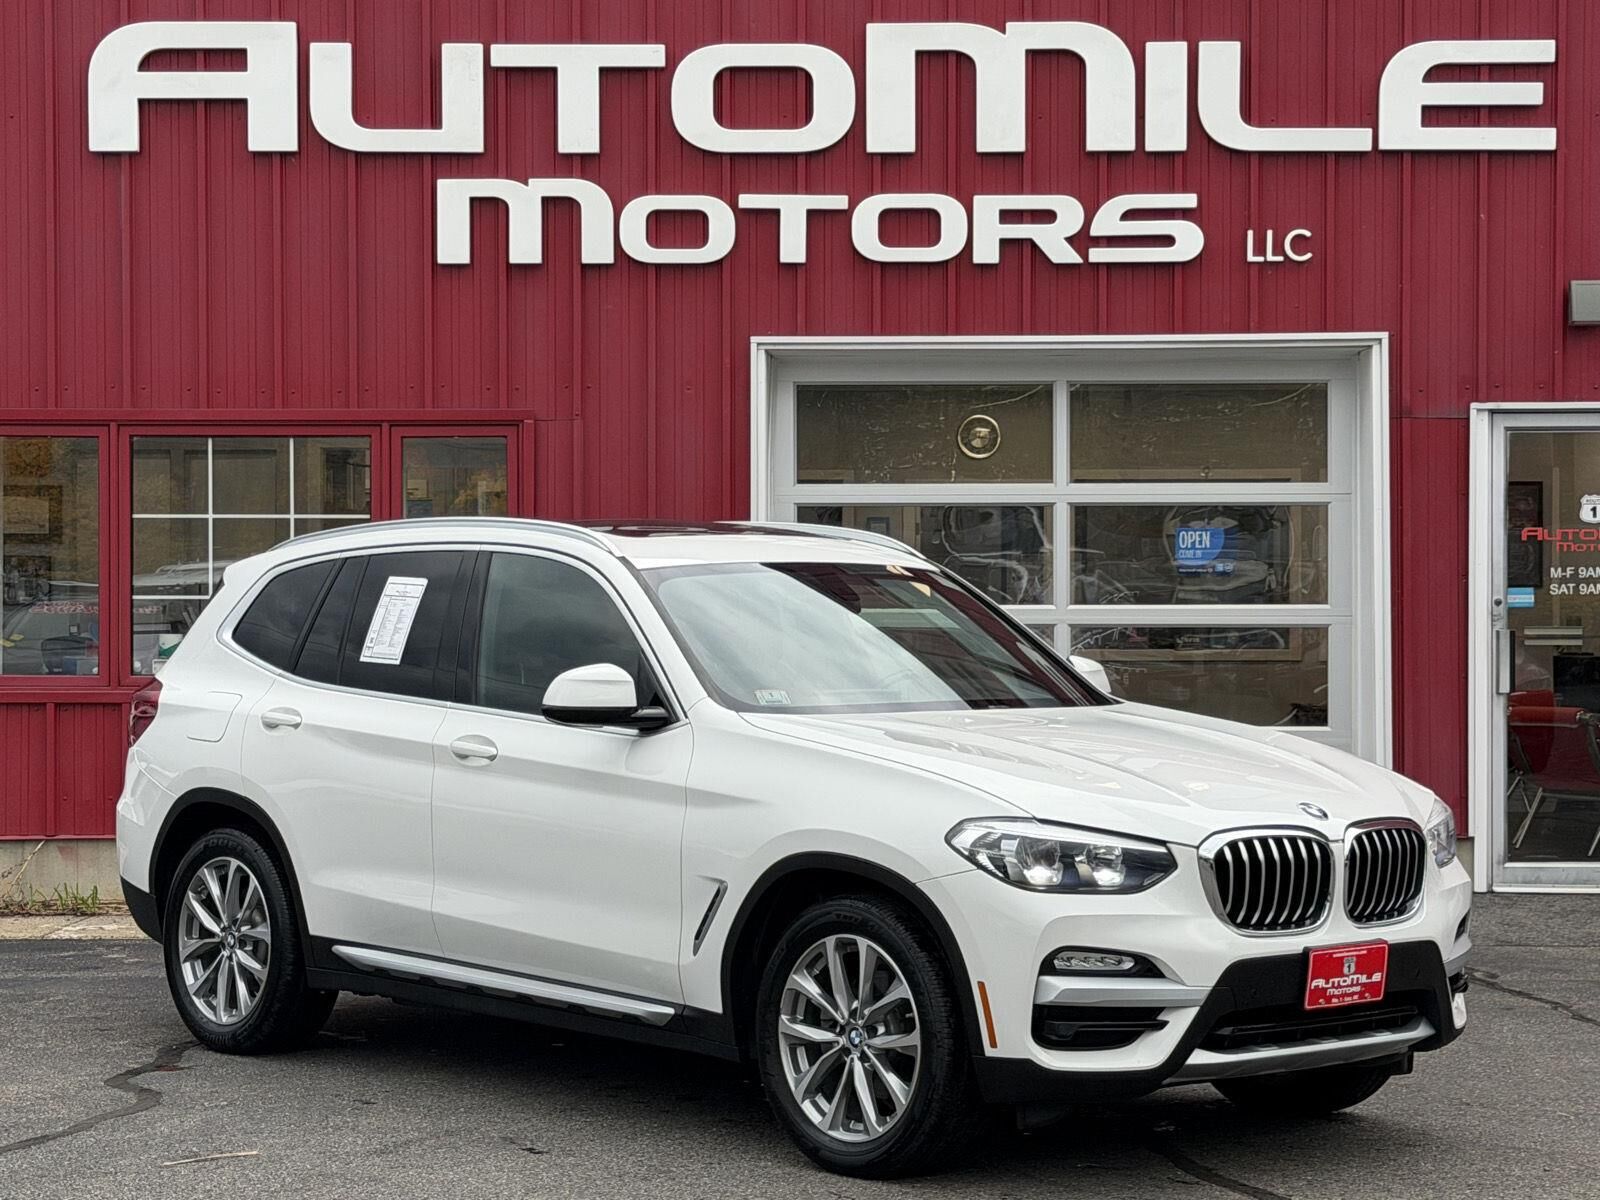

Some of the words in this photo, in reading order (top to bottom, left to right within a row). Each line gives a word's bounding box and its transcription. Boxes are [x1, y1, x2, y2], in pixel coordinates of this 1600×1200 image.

[88, 21, 1557, 153] AUTOMILE
[436, 177, 1205, 264] MOTORS
[1246, 228, 1313, 262] LLC
[1179, 531, 1210, 548] OPEN
[1521, 527, 1600, 541] AUTO
[1556, 542, 1600, 553] MOT
[1550, 567, 1575, 578] M-F
[1549, 583, 1575, 595] SAT
[1311, 972, 1382, 989] AUTOMILE
